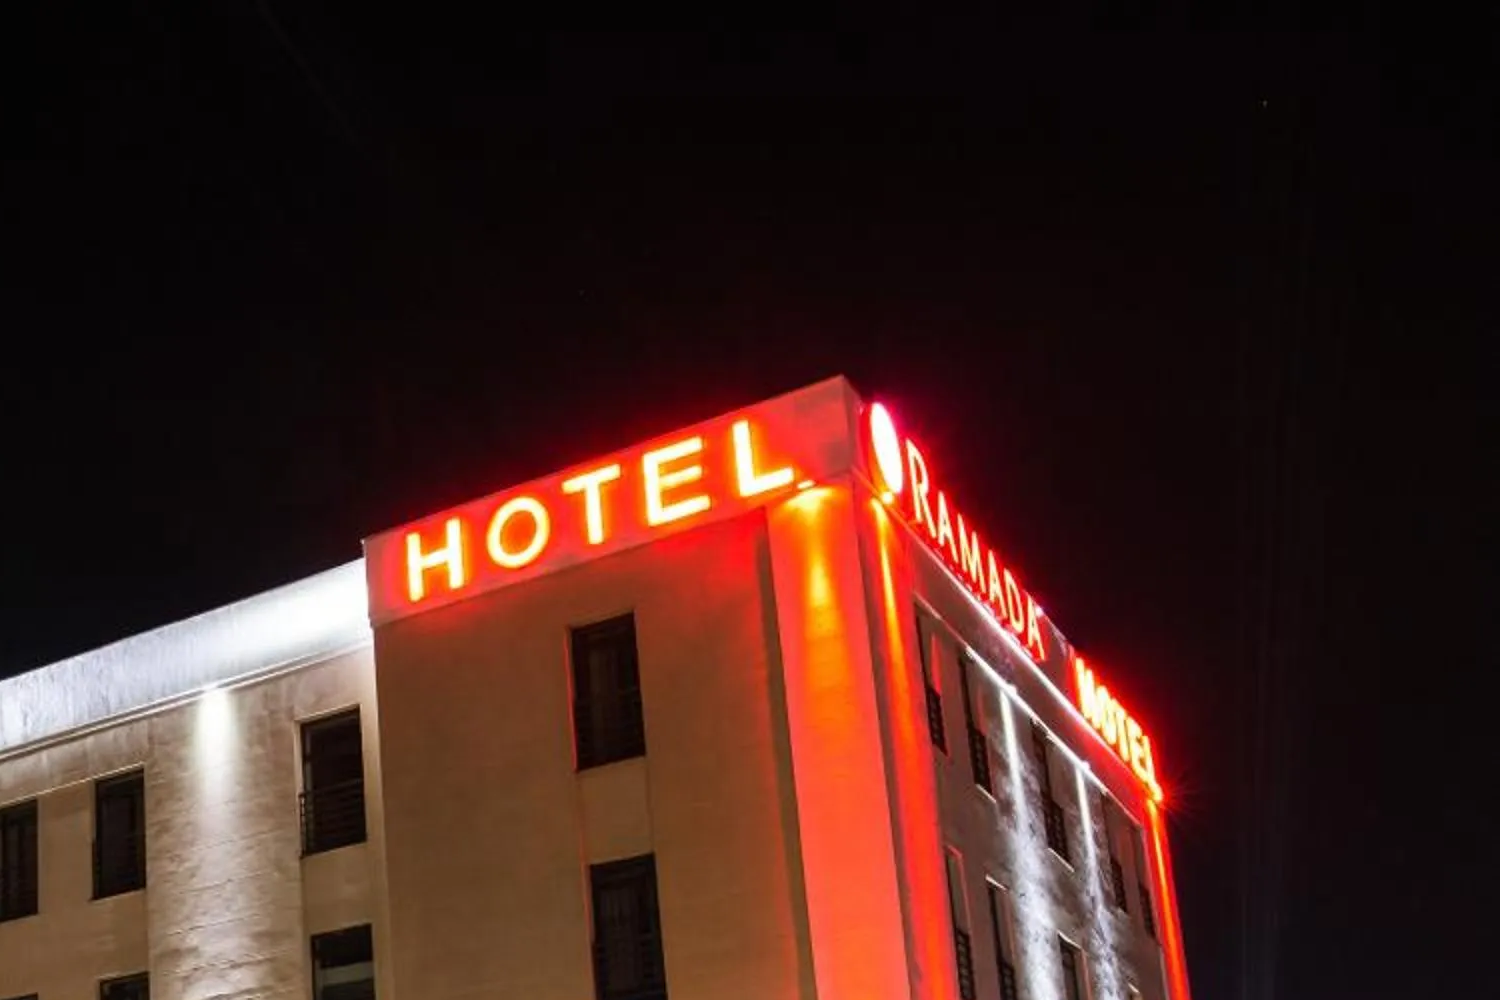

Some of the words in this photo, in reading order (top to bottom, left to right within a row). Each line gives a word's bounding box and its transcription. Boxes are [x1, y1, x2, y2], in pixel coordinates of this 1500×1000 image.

[405, 419, 795, 601] HOTEL
[905, 437, 1046, 662] RAMADA
[1075, 657, 1164, 803] HOTEL
